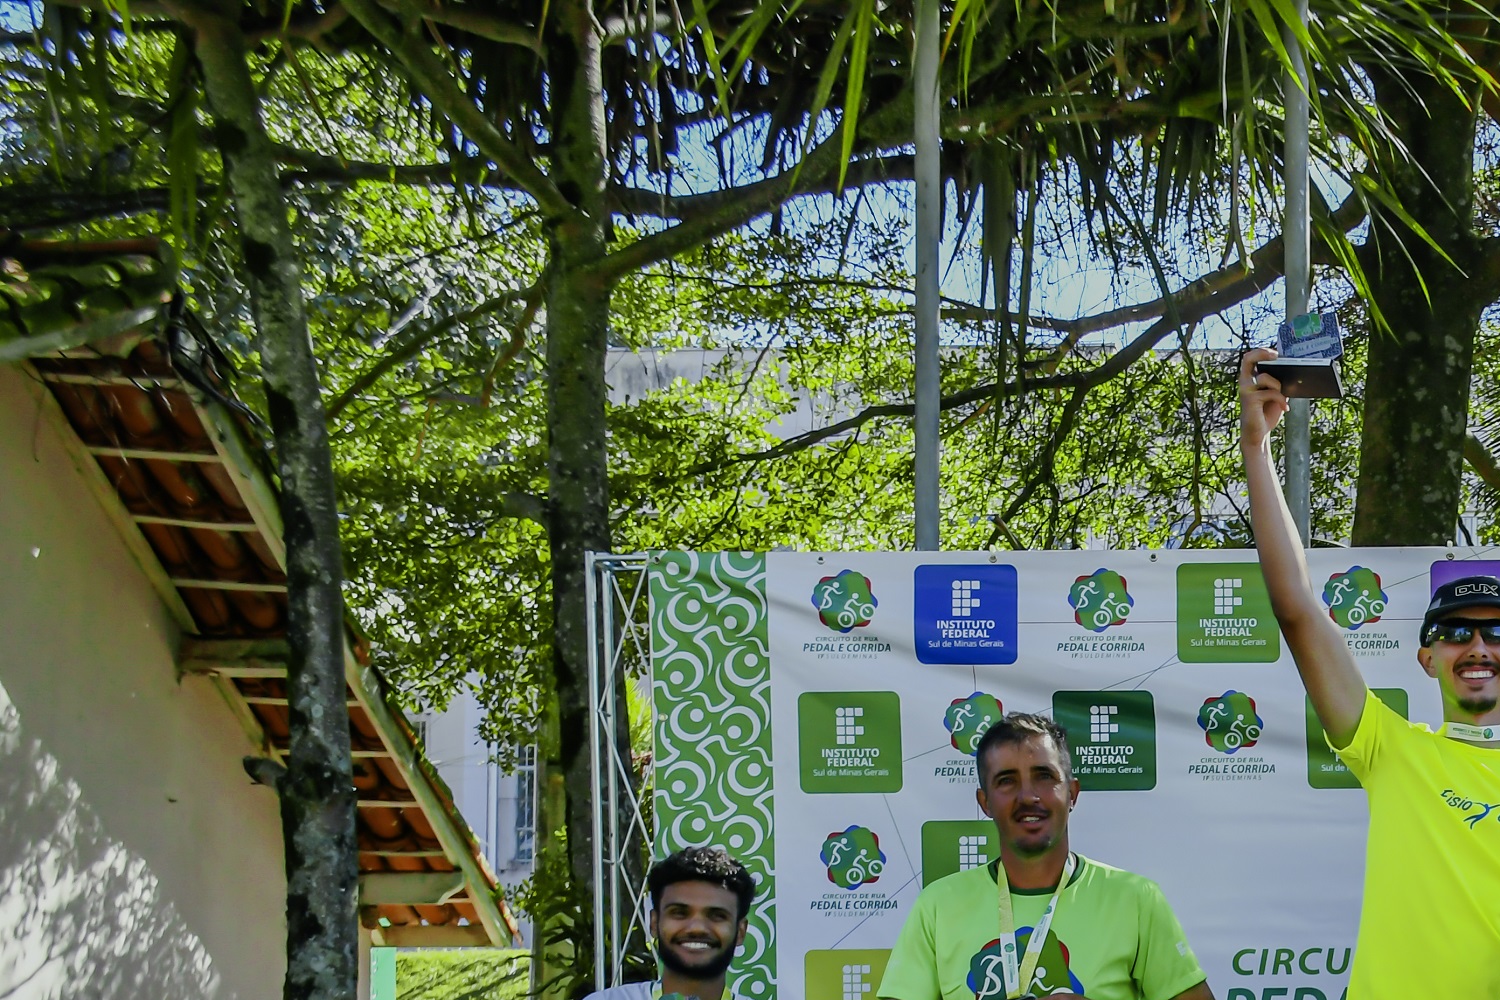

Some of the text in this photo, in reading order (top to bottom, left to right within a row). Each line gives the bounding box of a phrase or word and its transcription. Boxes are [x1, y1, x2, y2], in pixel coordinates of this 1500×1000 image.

[1455, 583, 1498, 596] DUX
[937, 620, 995, 630] INSTITUTO
[1200, 618, 1257, 627] INSTITUTO
[942, 629, 990, 639] FEDERAL
[1205, 627, 1251, 637] FEDERAL
[928, 641, 940, 649] Sul
[942, 641, 952, 649] de
[1216, 638, 1239, 646] Minas
[1241, 638, 1266, 646] Gerais
[1355, 640, 1399, 649] CORRIDA
[803, 643, 891, 652] PEDAL E CORRIDA
[1057, 643, 1145, 652] PEDAL E CORRIDA
[822, 748, 879, 758] INSTITUTO
[1076, 746, 1133, 755] INSTITUTO
[827, 757, 874, 767] FEDERAL
[1081, 755, 1128, 765] FEDERAL
[813, 769, 825, 777] Sul
[863, 768, 888, 776] Gerais
[935, 767, 975, 776] PEDAL E
[1117, 766, 1142, 774] Gerais
[1188, 764, 1275, 774] PEDAL E CORRIDA
[810, 900, 898, 910] PEDAL E CORRIDA
[1232, 947, 1351, 976] CIRCU
